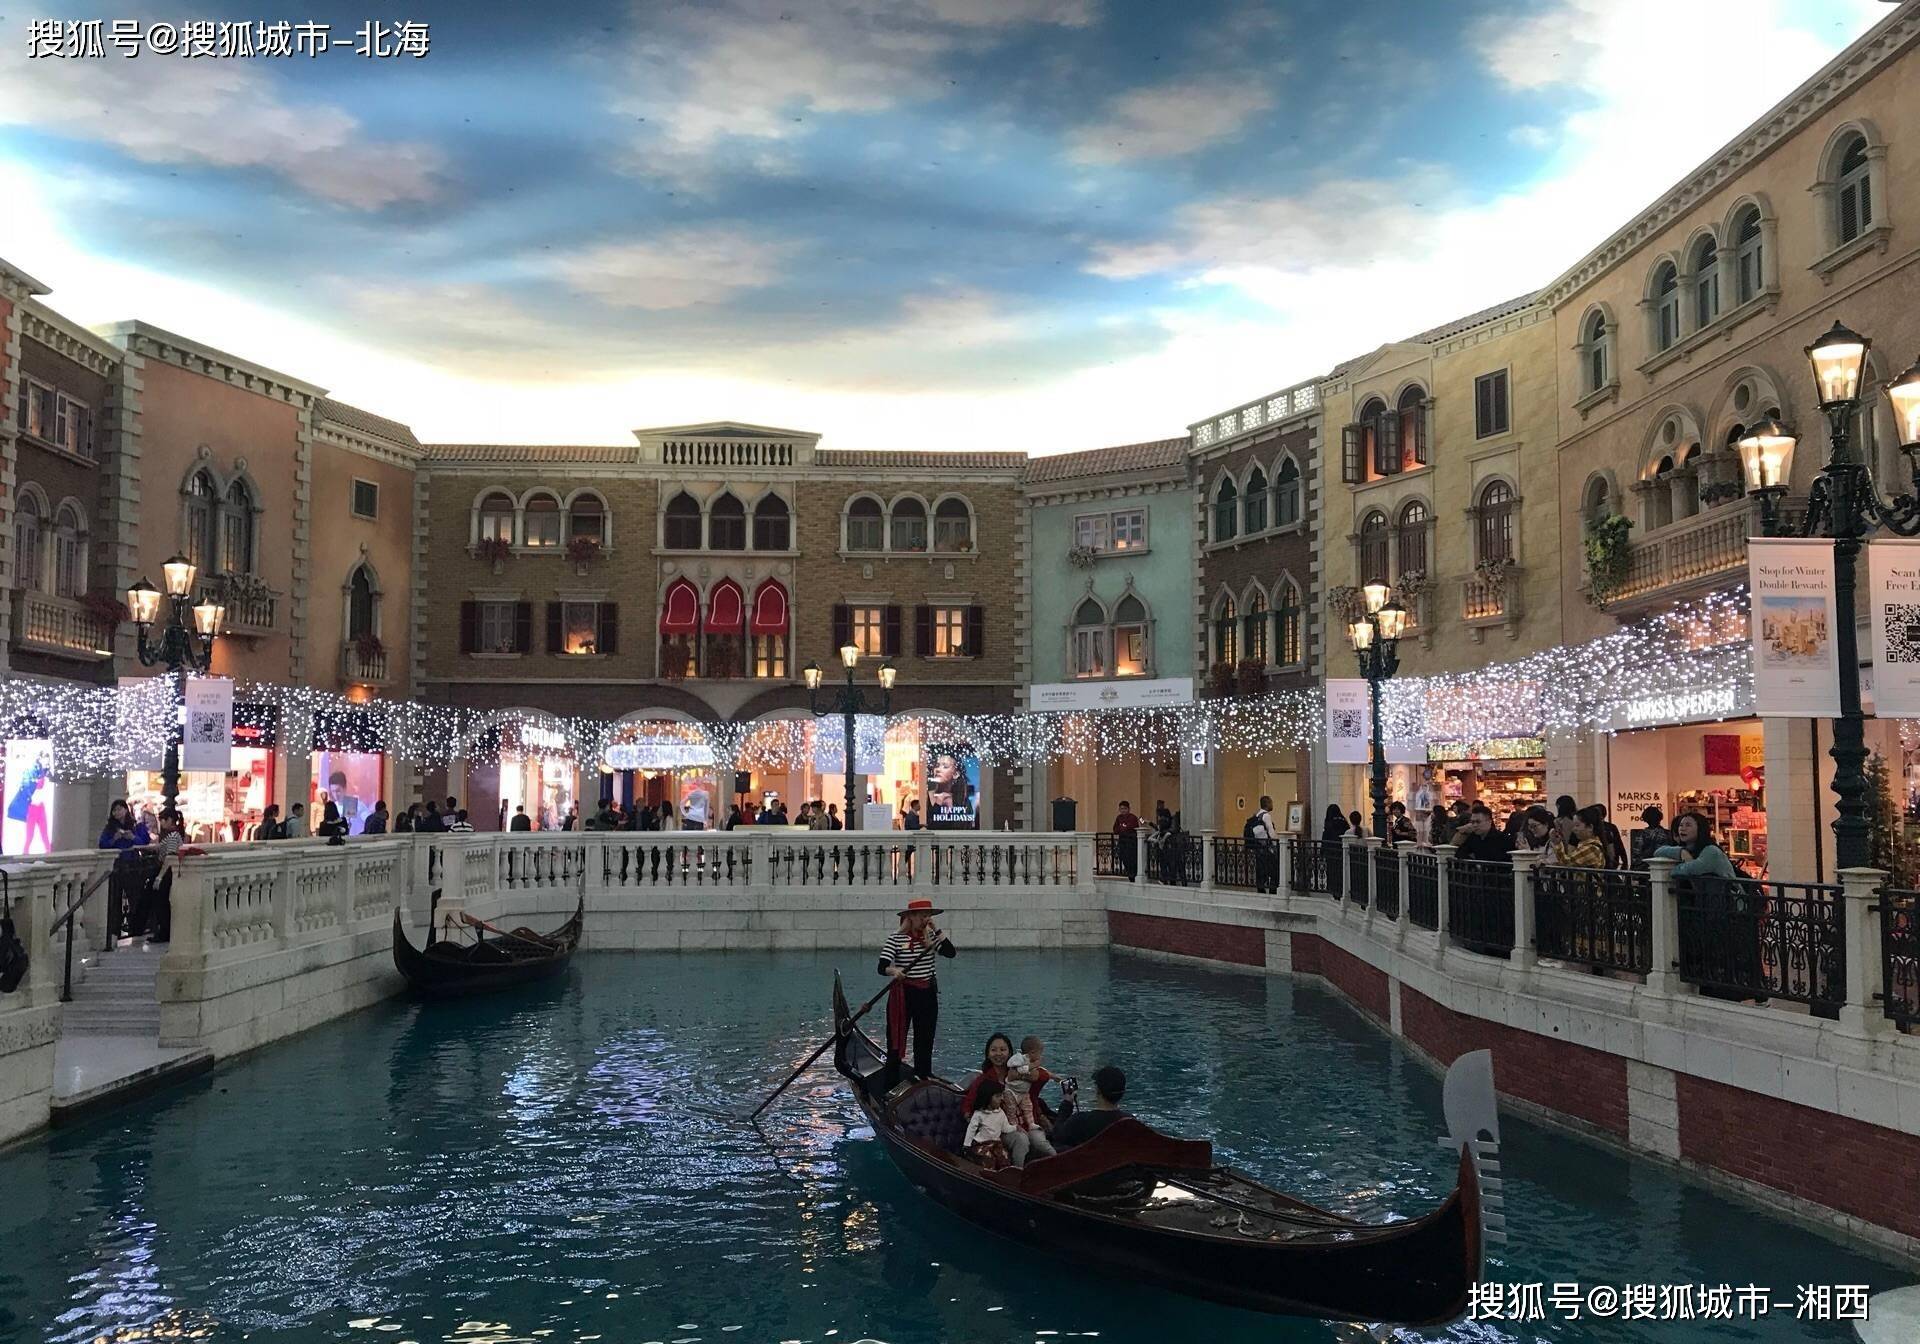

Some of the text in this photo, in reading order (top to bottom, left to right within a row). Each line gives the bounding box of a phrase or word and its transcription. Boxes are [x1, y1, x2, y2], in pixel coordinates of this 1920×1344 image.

[1759, 566, 1826, 577] Shop for Winter
[1891, 568, 1915, 578] Scan
[1759, 580, 1828, 590] Double Rewards
[1886, 580, 1908, 590] Free
[1618, 792, 1660, 800] MARKS &
[940, 806, 967, 814] HAPPY
[933, 814, 976, 822] HOLIDAYS!
